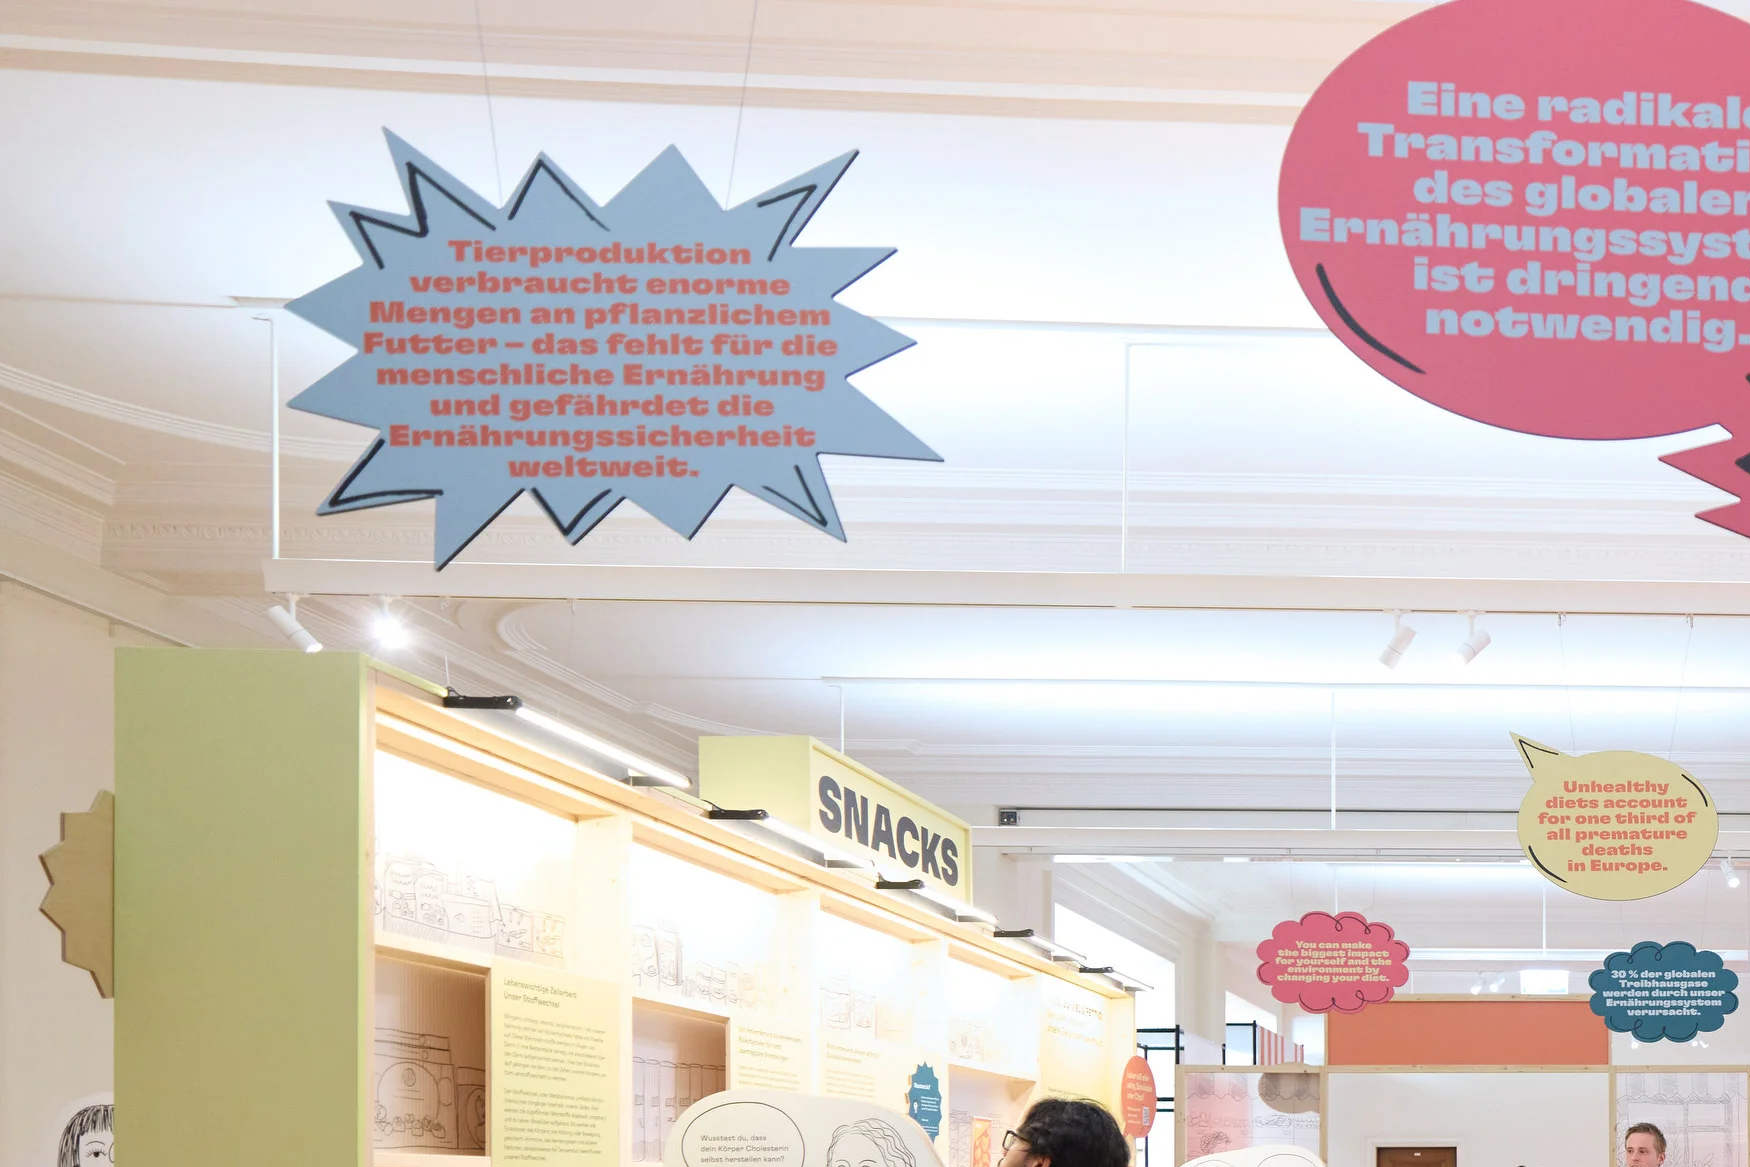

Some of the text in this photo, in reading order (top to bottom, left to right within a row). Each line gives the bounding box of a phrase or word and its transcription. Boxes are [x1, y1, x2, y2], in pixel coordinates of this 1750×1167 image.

[1408, 81, 1524, 120] Eine
[1414, 170, 1512, 206] des
[448, 239, 751, 266] Tierproduktion
[1414, 257, 1494, 292] ist
[410, 272, 790, 296] verbraucht enorme
[369, 301, 830, 329] Mengen an pflanzlichem
[363, 332, 498, 354] Futter
[531, 333, 598, 355] das
[606, 333, 703, 355] fehlt
[711, 333, 773, 355] für
[781, 335, 838, 356] die
[376, 364, 826, 391] menschliche Ernährung
[430, 394, 774, 421] und gefährdet die
[389, 424, 816, 451] Ernährungssicherheit
[508, 455, 699, 478] weltweit.
[1563, 780, 1670, 795] Unhealthy
[1545, 797, 1688, 809] diets account
[1538, 812, 1697, 825] for one third of
[818, 775, 959, 887] SNACKS
[1546, 828, 1688, 843] all premature
[1581, 844, 1654, 856] deaths
[1567, 860, 1668, 874] in Europe.
[1278, 949, 1390, 958] the biggest impact
[1275, 957, 1295, 965] for
[1296, 957, 1347, 966] yourself
[1348, 957, 1369, 965] and
[1287, 966, 1380, 975] environment by
[1611, 970, 1716, 980] 30 % der globalen
[1276, 974, 1331, 983] changing
[1361, 974, 1390, 982] diet.
[1618, 979, 1709, 989] Treibhausgase
[1602, 988, 1726, 997] werden durch unser
[1605, 998, 1722, 1008] Ernährungssystem
[1626, 1008, 1702, 1016] verursacht.
[700, 1134, 736, 1142] Wusstest
[718, 1145, 744, 1153] Körper
